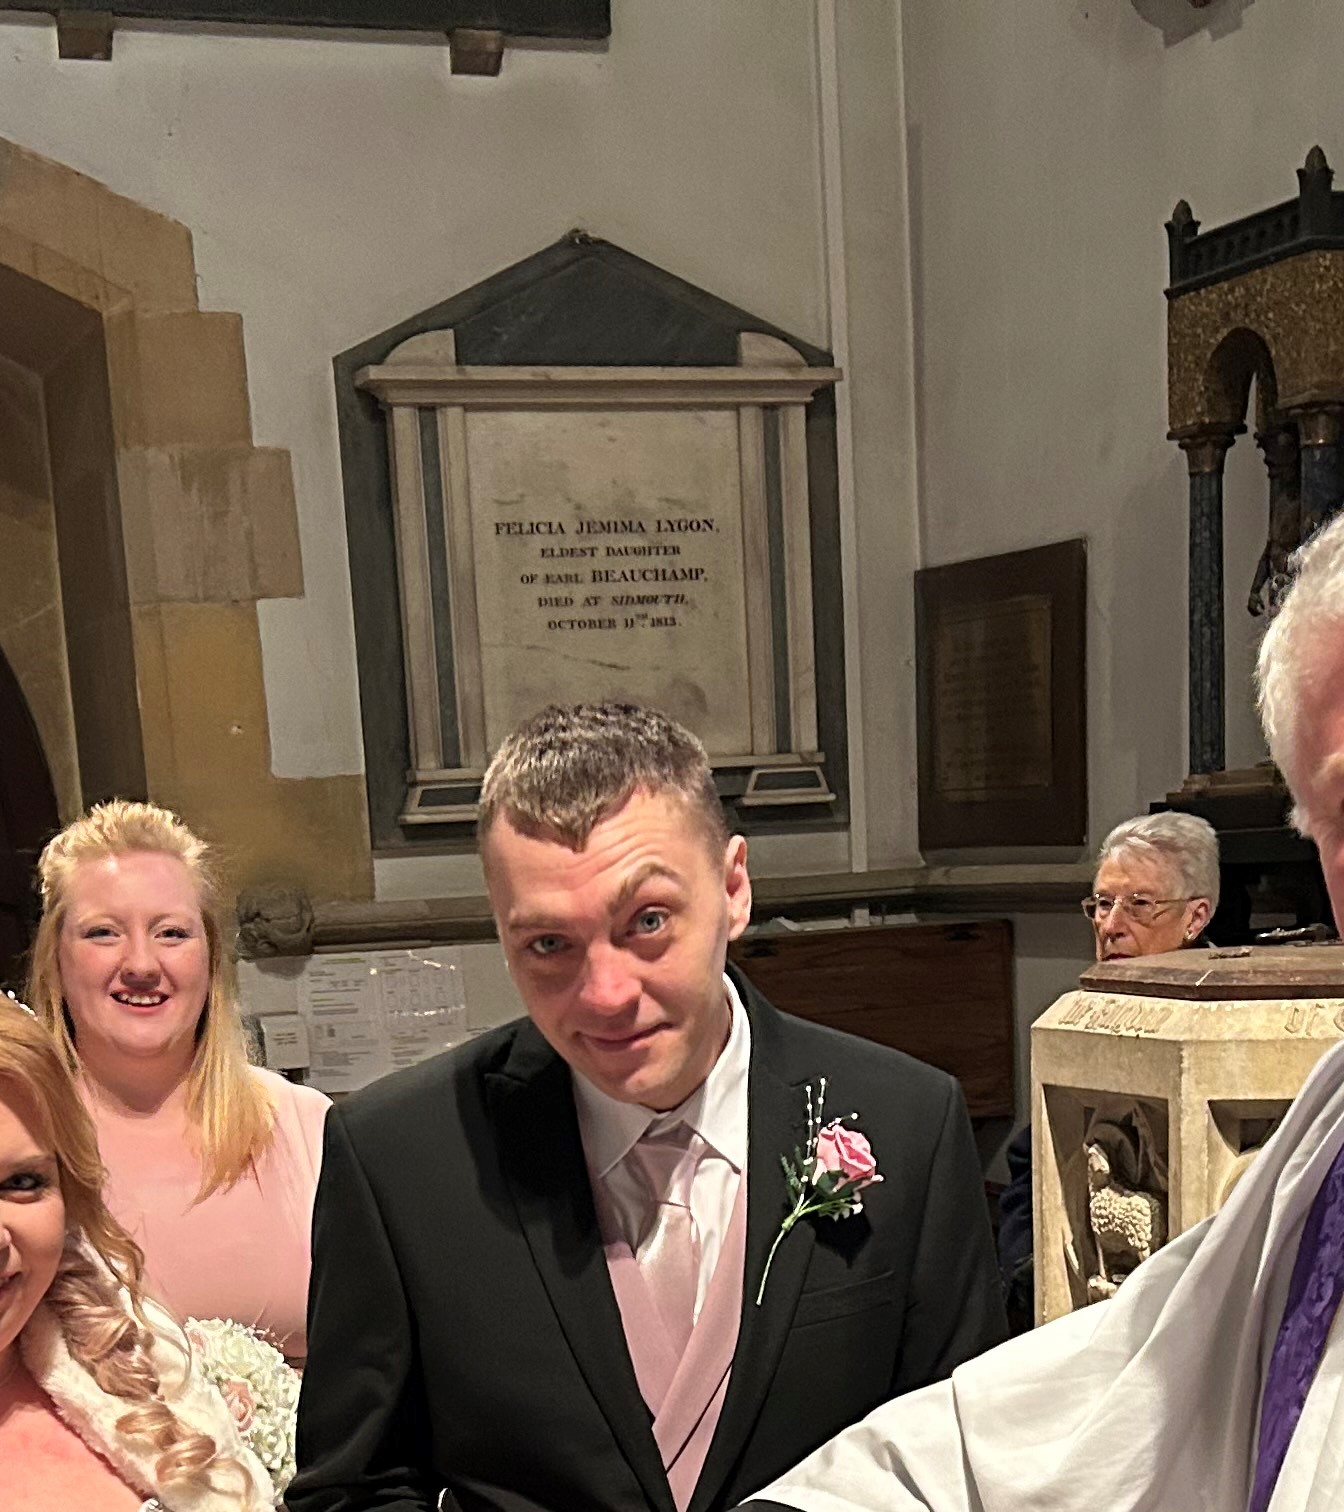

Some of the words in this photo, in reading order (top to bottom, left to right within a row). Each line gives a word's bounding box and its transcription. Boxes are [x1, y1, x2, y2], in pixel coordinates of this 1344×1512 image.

[494, 520, 565, 536] FELICIA
[575, 519, 646, 535] JEMIMA
[540, 546, 599, 559] ELDEST
[605, 545, 681, 557] DAUGHTER
[520, 573, 538, 584] OF
[542, 572, 584, 584] EARL
[537, 596, 574, 608] DIED
[582, 595, 601, 607] AT
[547, 617, 617, 631] OCTOBER
